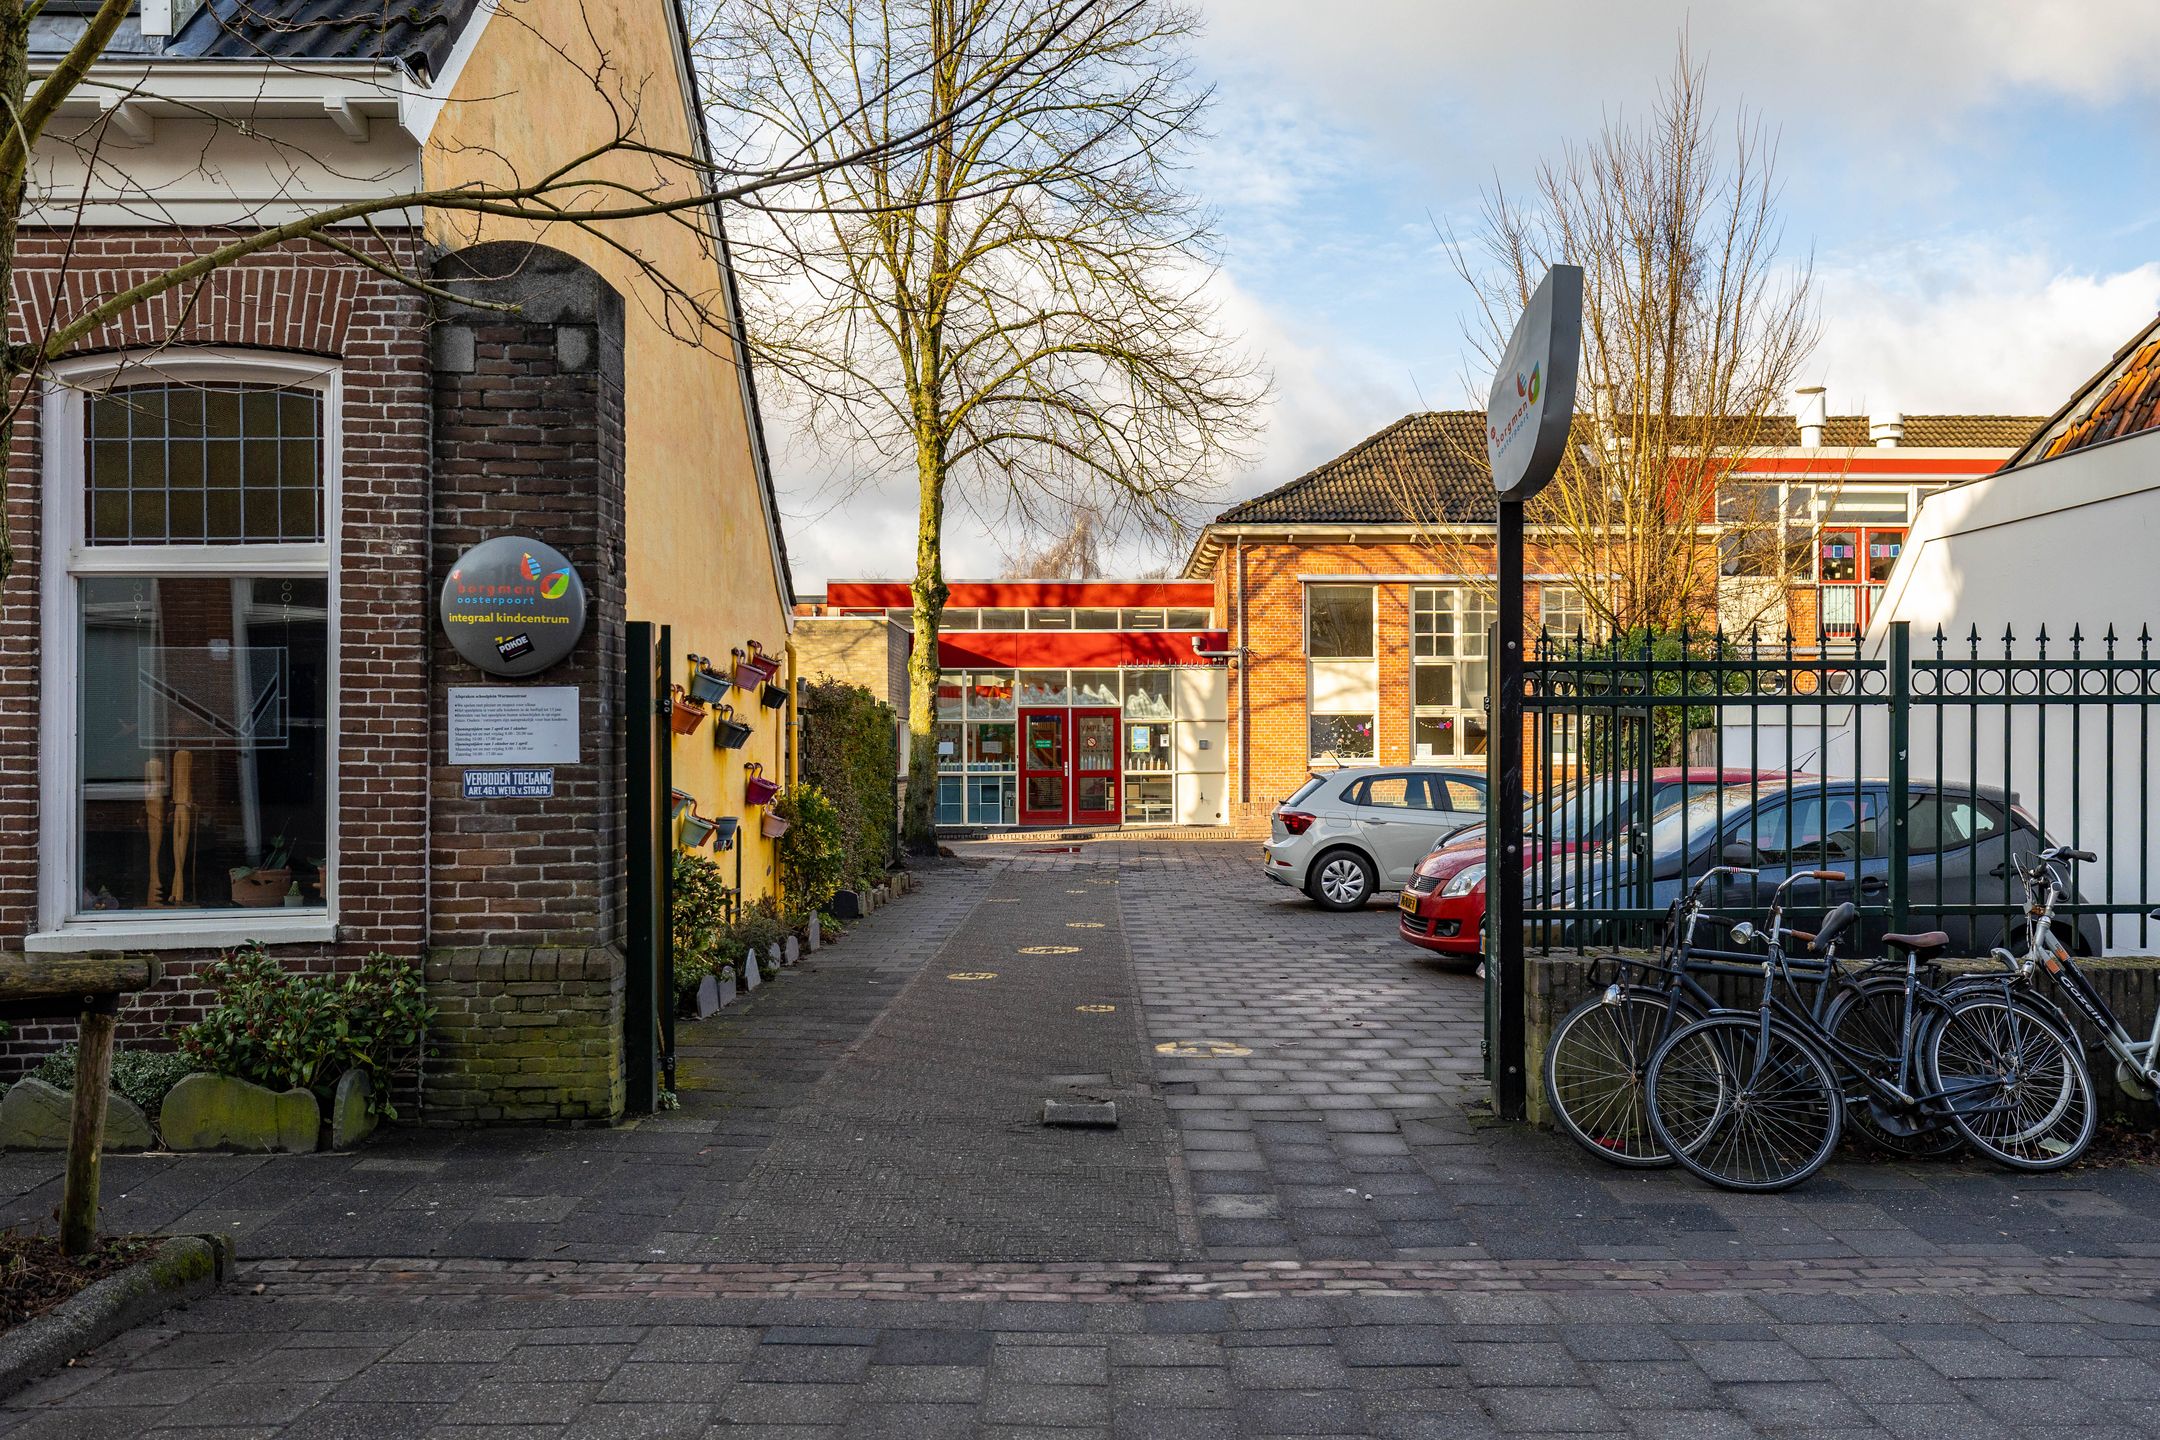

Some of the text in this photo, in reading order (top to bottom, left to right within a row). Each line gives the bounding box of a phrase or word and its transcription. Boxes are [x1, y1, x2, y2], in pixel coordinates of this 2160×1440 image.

[1496, 401, 1528, 448] borgman
[1498, 413, 1529, 458] oosterpoort
[457, 583, 536, 598] borgman
[456, 596, 535, 606] oosterpoort
[448, 612, 570, 624] integraal kindcentrum
[498, 635, 529, 654] POKOE
[465, 772, 551, 785] VERBODEN TOEGANG
[2060, 976, 2108, 1027] Gazelle
